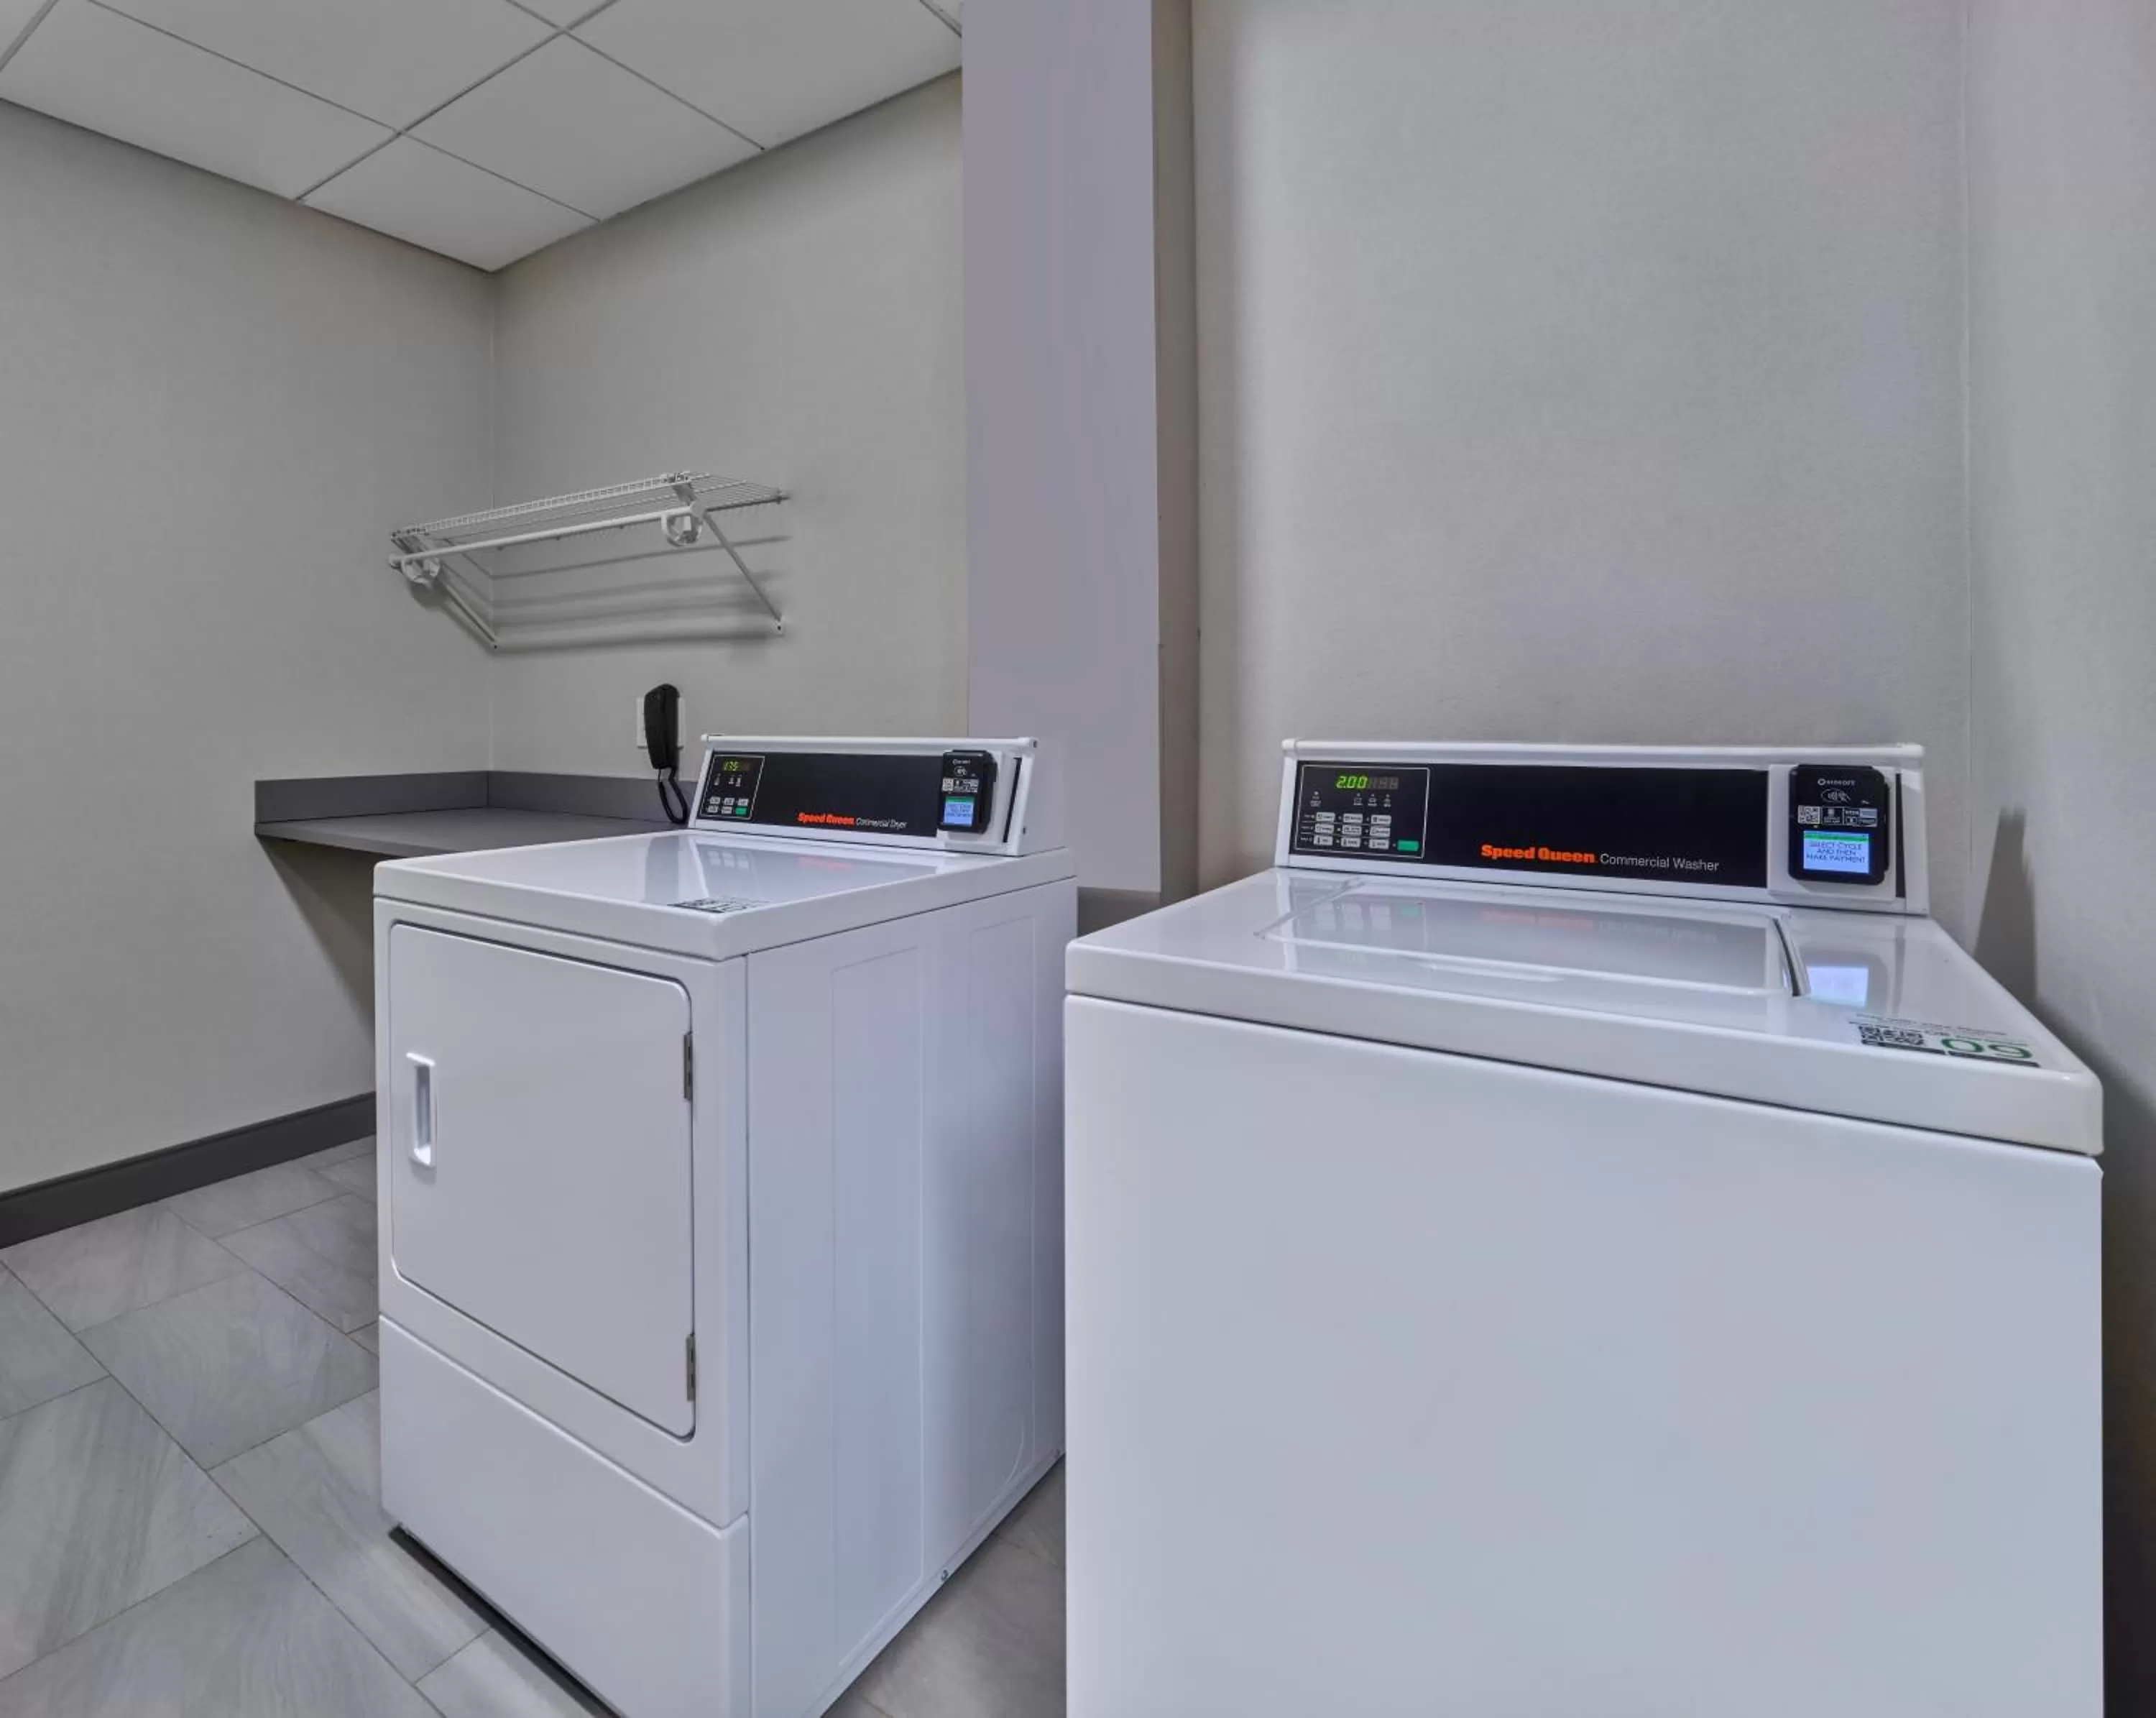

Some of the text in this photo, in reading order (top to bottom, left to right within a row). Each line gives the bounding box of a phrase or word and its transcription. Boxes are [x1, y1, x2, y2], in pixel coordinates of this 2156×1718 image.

[1336, 776, 1368, 789] 2.00
[798, 812, 907, 830] Speed Queen Commercial Dryer
[1480, 845, 1720, 871] Speed Queen Commercial Washer
